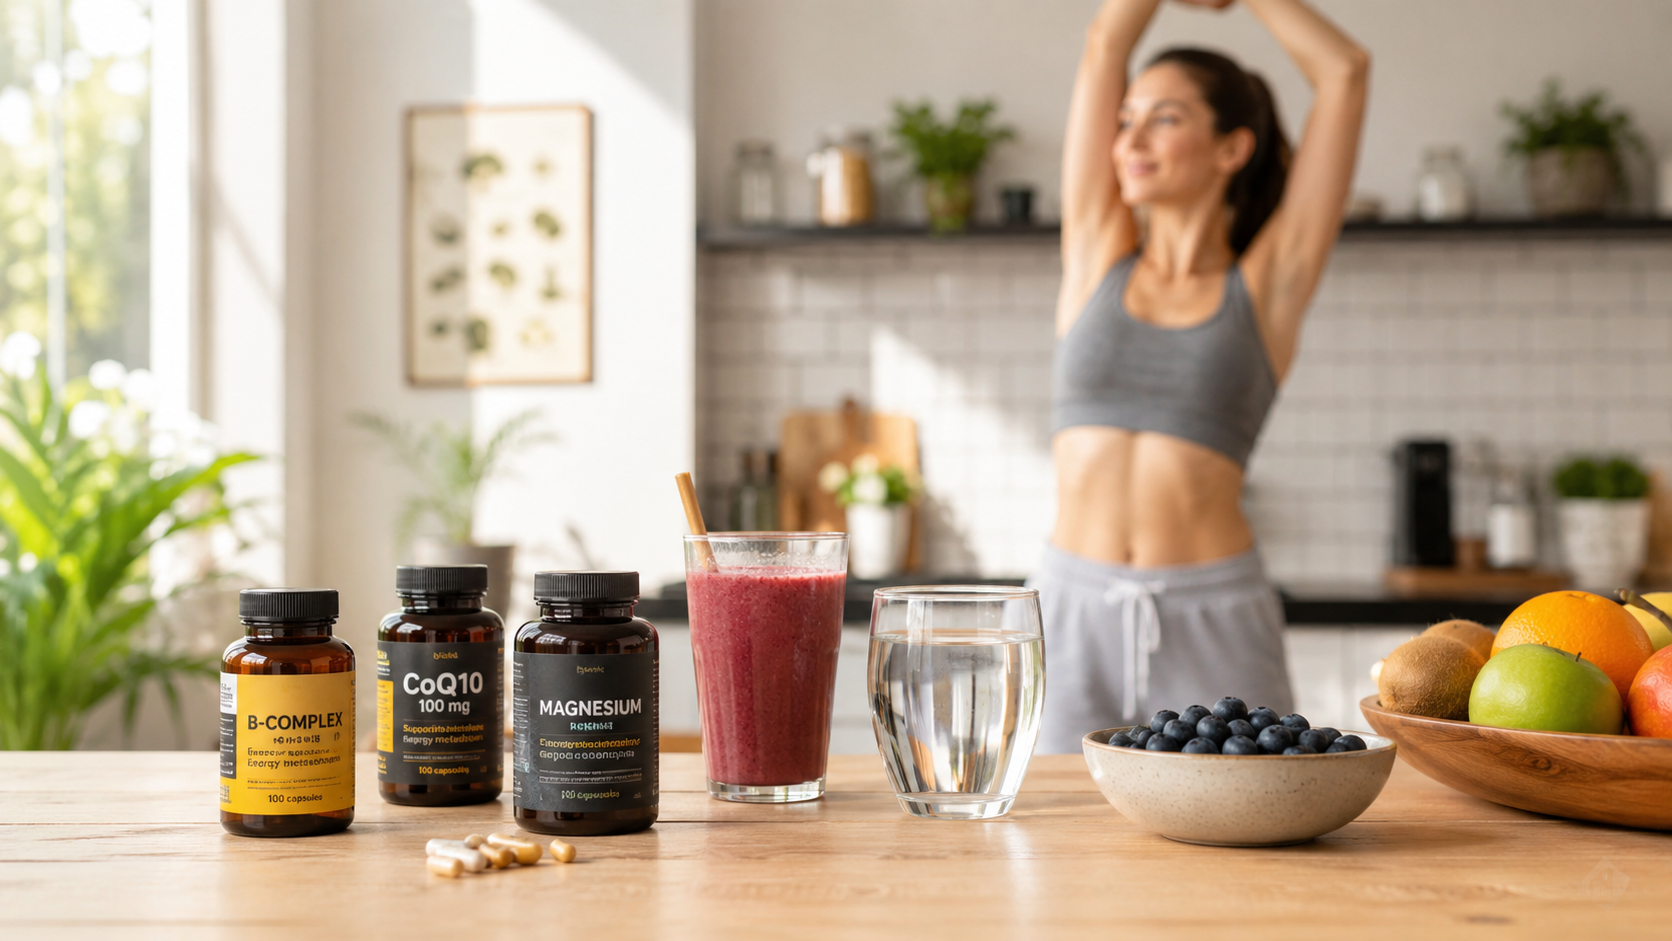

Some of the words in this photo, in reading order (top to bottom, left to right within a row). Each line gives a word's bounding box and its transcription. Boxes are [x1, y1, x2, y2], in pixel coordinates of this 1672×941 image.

[403, 671, 484, 697] CoQ10
[419, 699, 445, 713] 100
[448, 701, 471, 715] mg
[540, 698, 642, 716] MAGNESIUM
[247, 712, 343, 730] B-COMPLEX
[418, 766, 433, 775] 100
[268, 794, 285, 803] 100
